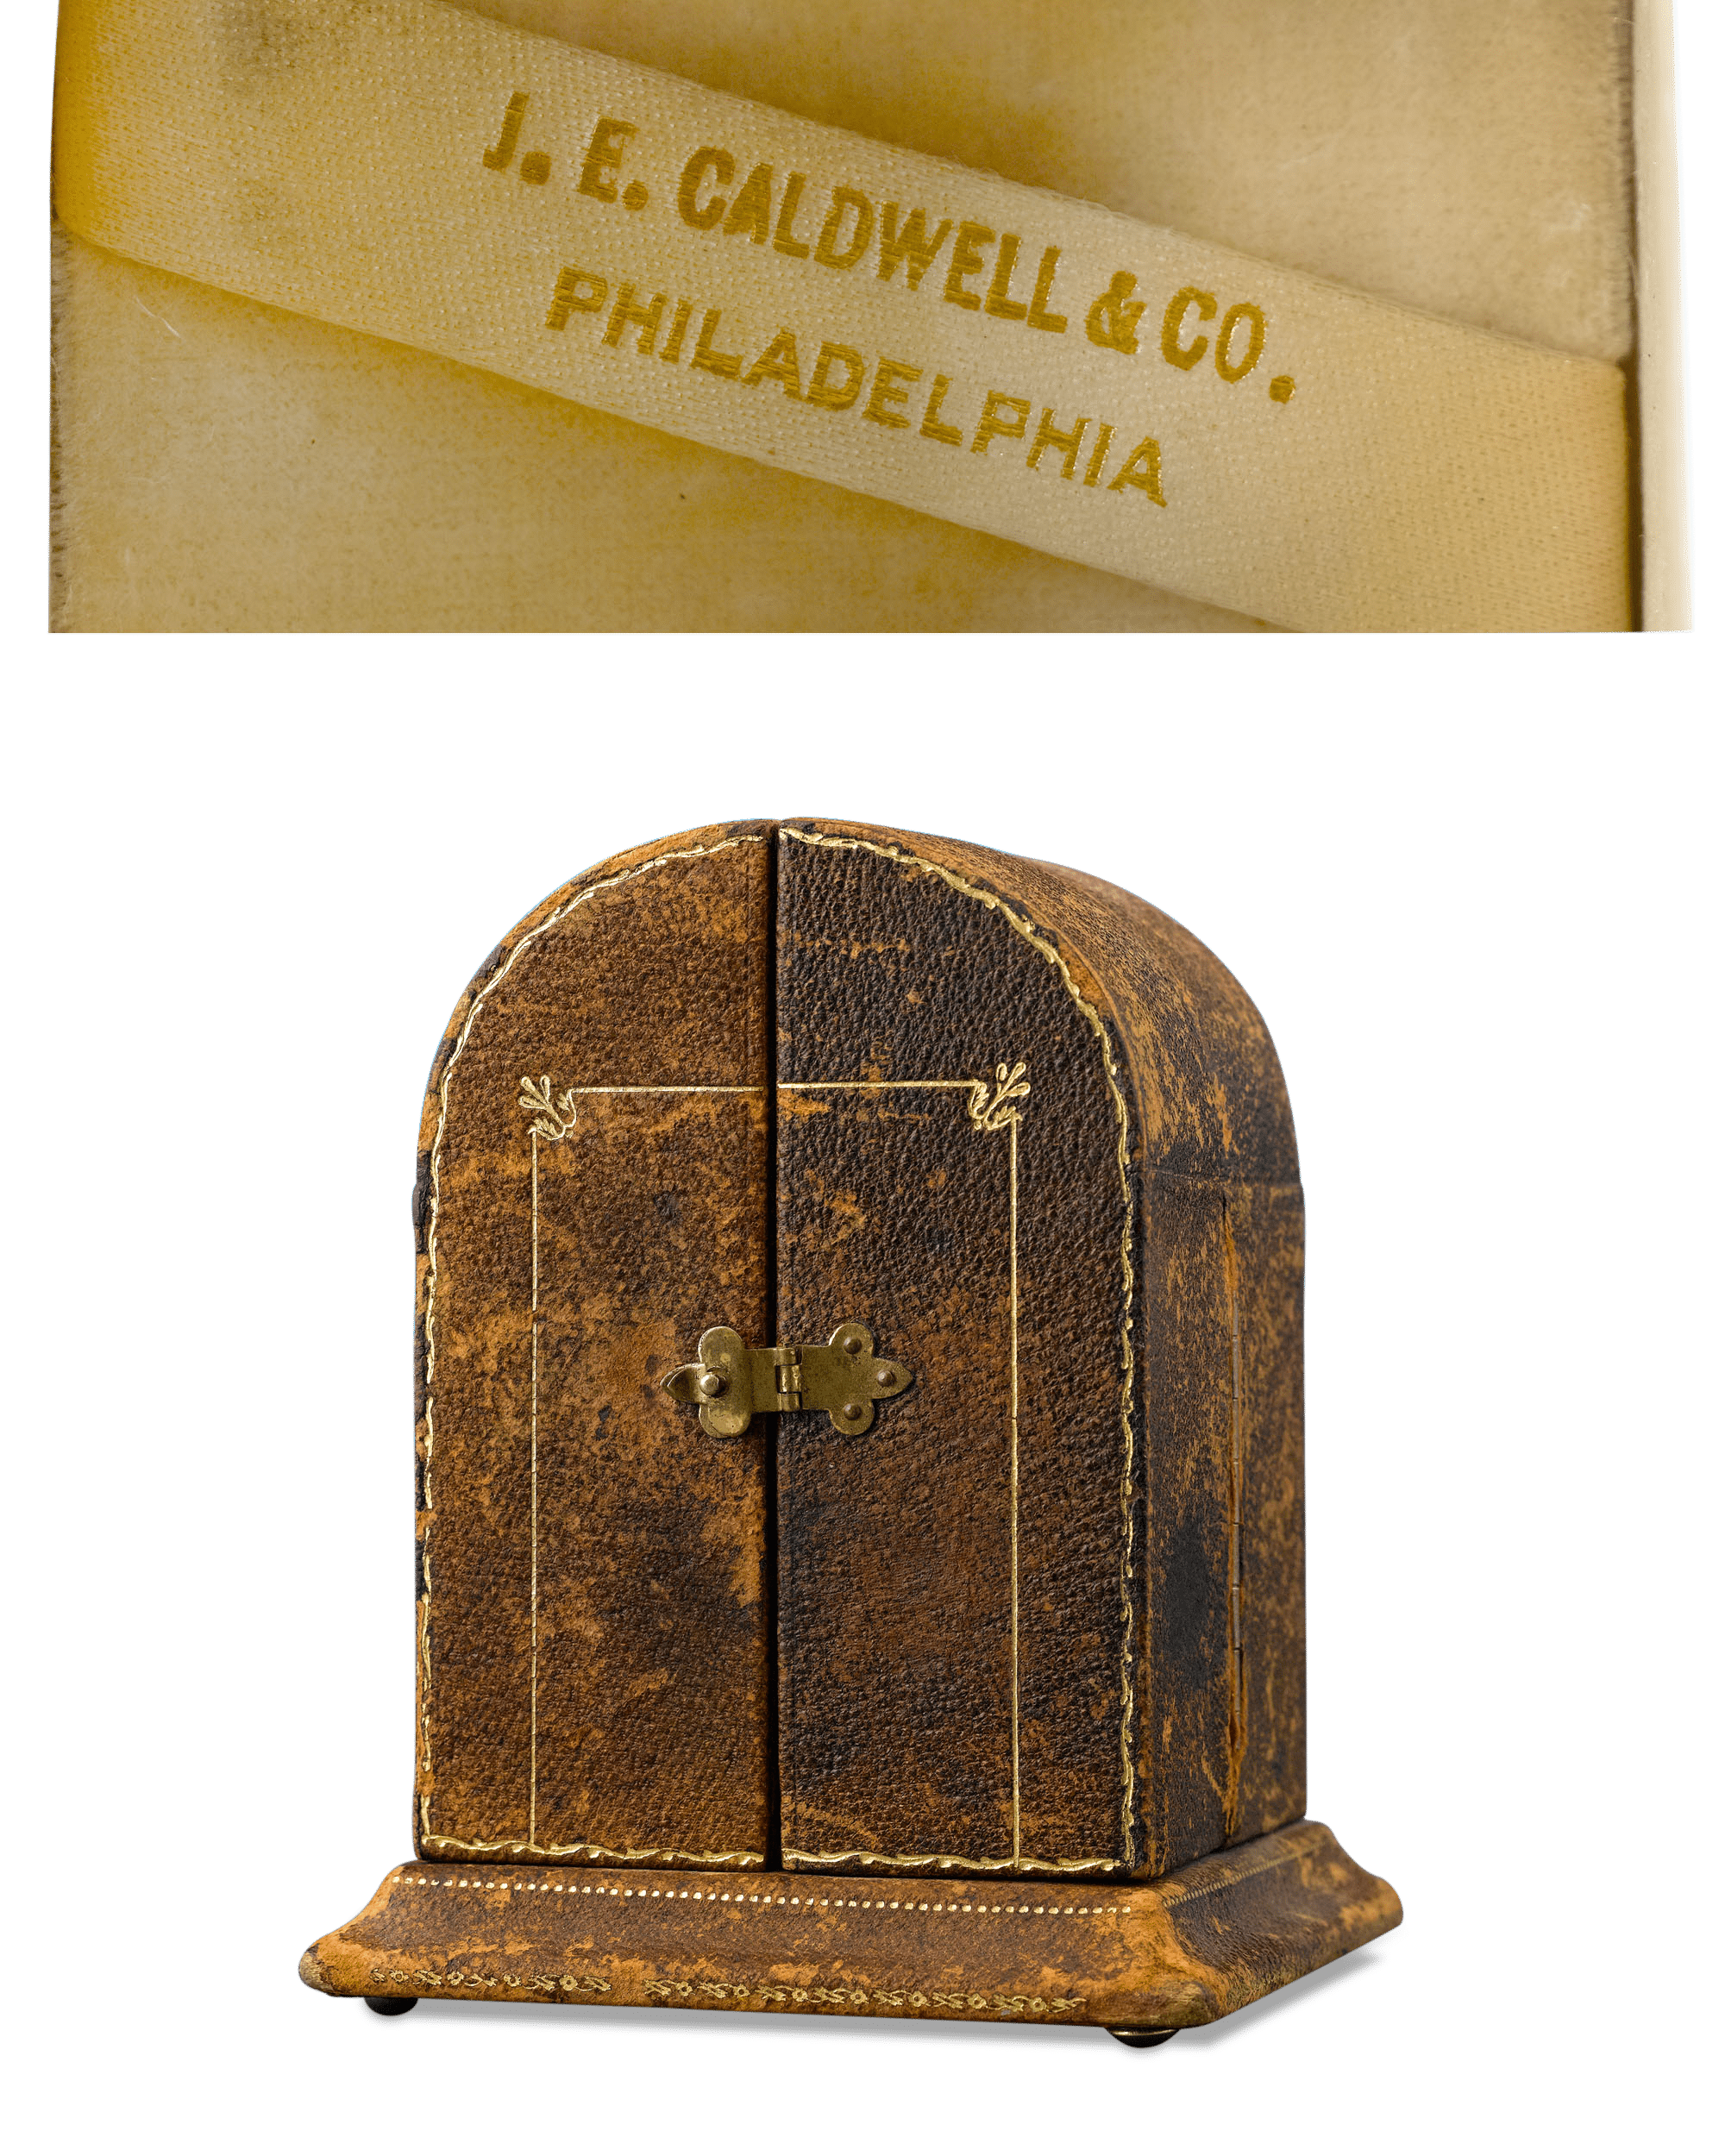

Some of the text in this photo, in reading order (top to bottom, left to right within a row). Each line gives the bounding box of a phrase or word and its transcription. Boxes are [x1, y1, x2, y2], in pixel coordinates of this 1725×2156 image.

[483, 91, 1296, 405] J. E. CALDWELL & CO.
[544, 266, 1168, 509] PHILADELPHIA
